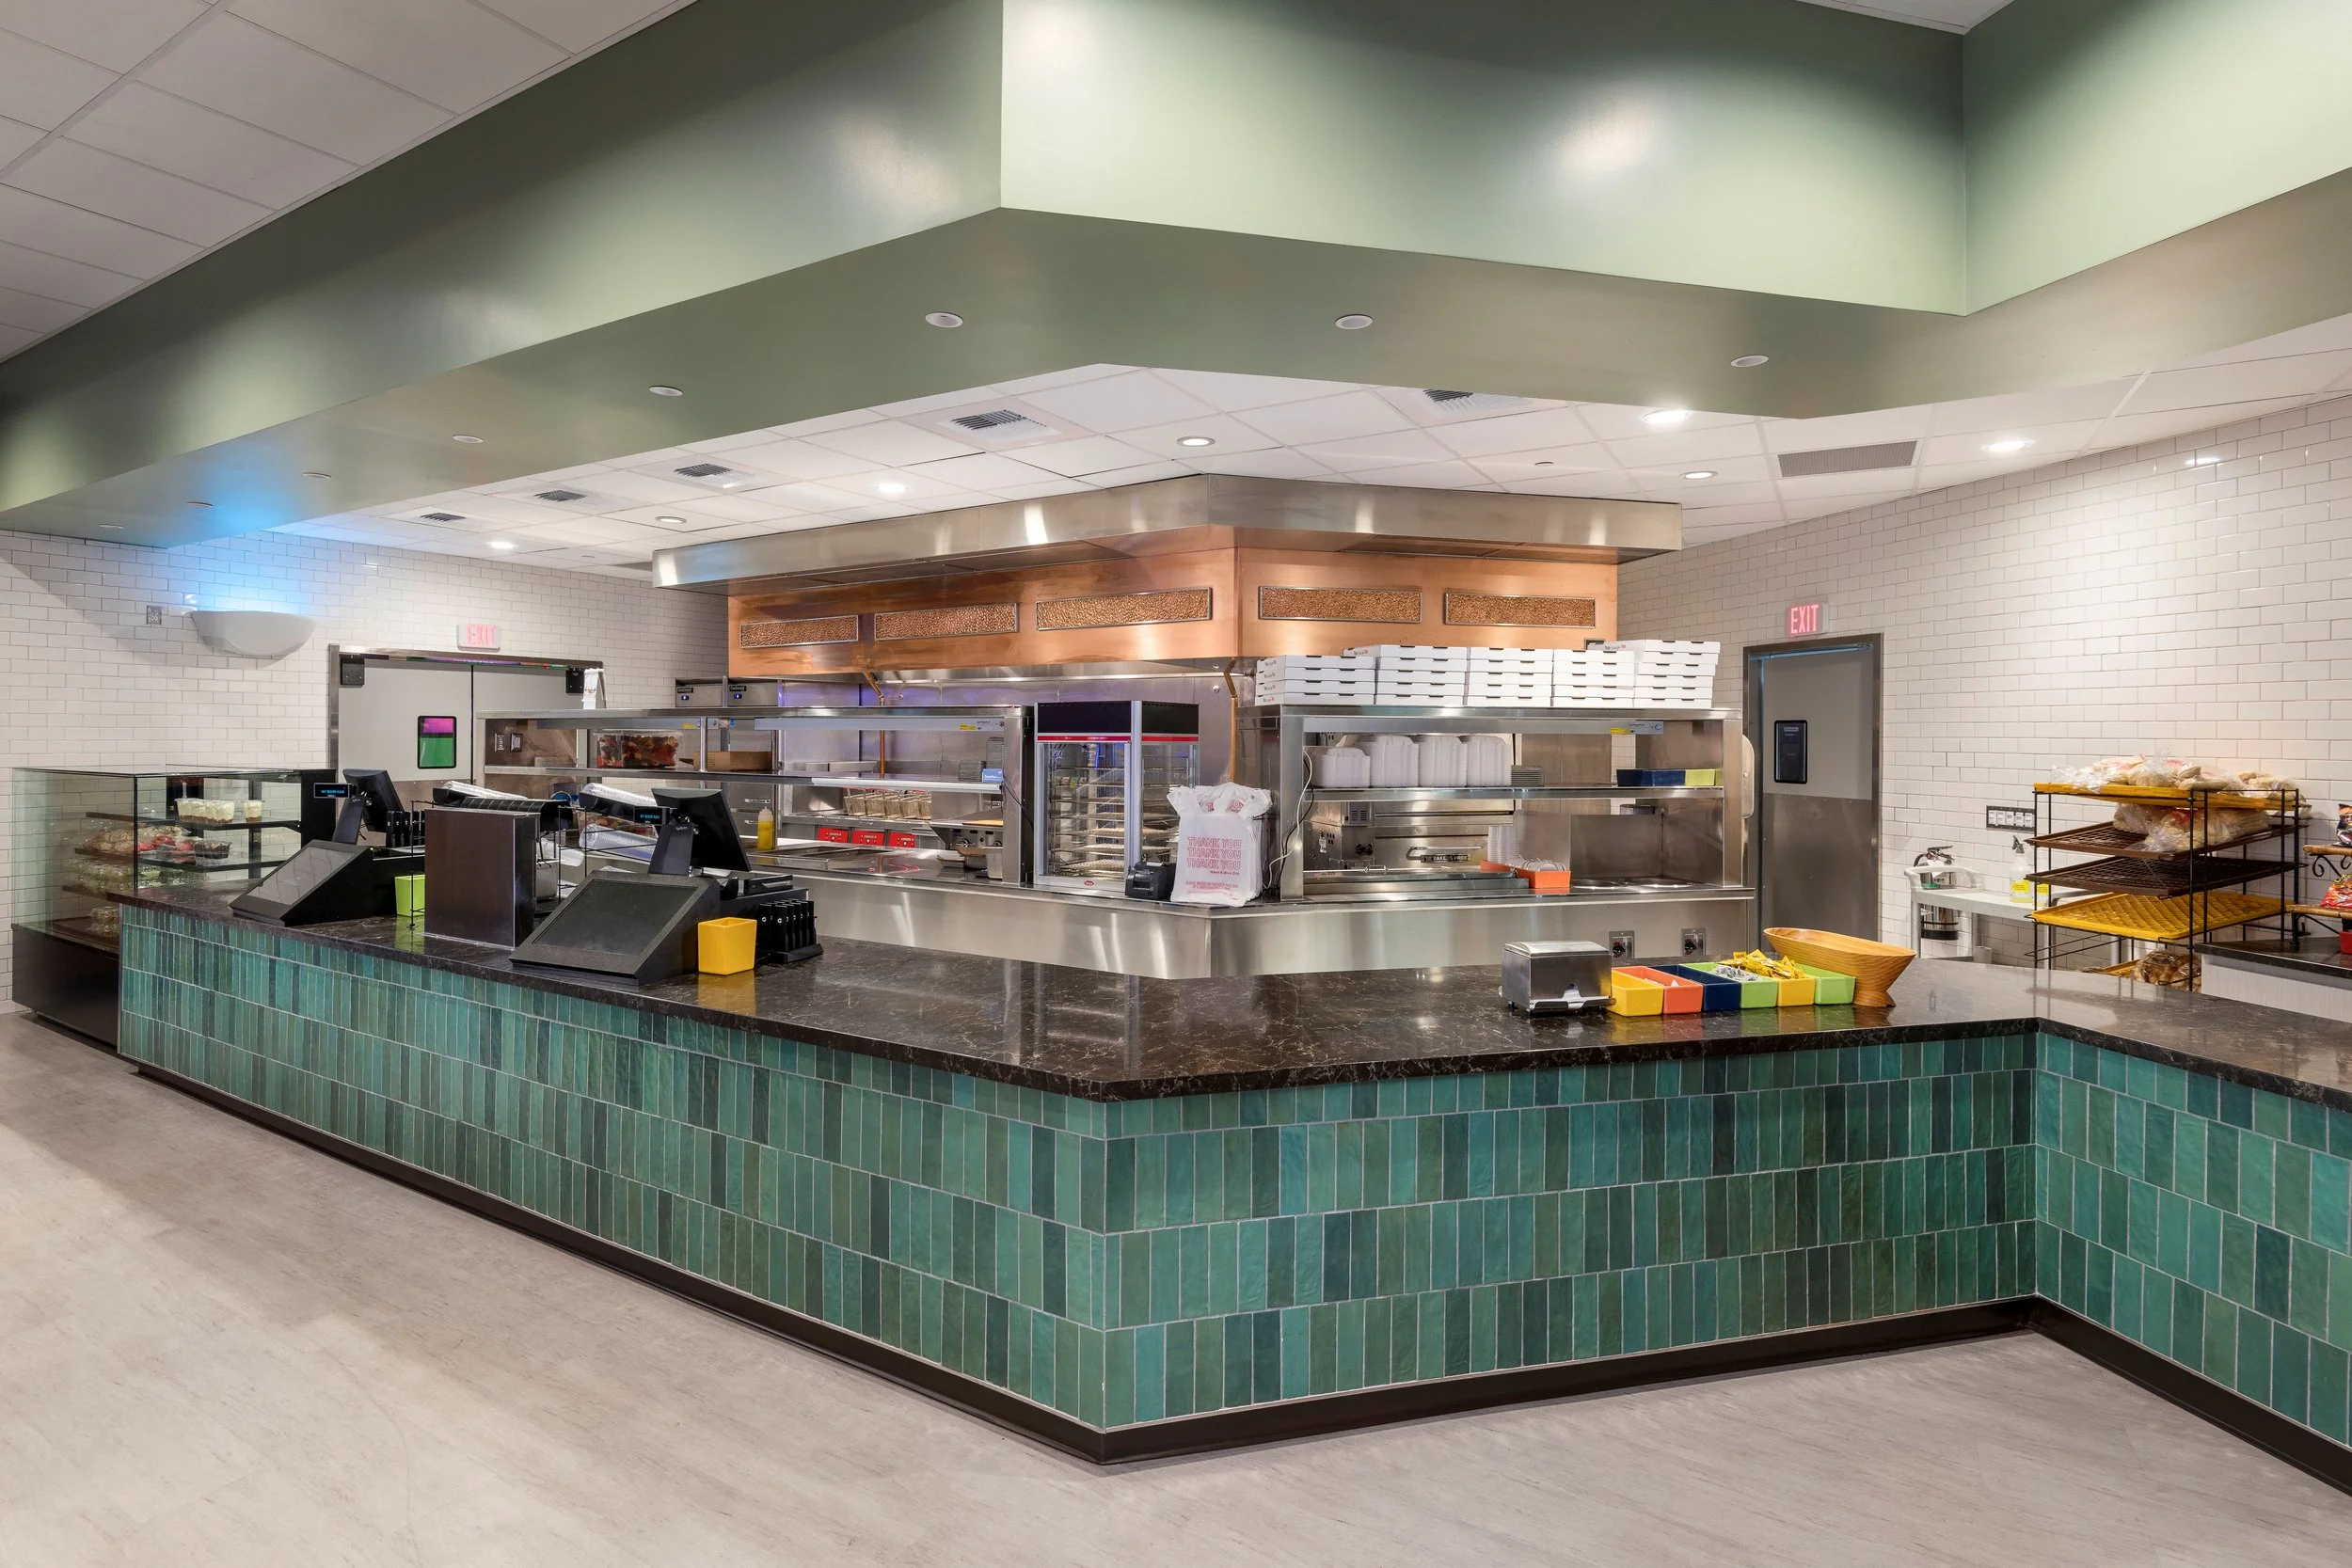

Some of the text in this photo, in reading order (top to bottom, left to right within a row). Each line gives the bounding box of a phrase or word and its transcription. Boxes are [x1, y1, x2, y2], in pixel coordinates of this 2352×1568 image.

[1790, 604, 1819, 634] EXIT
[467, 623, 496, 647] EXIT
[1187, 836, 1242, 848] THANK YOU
[1187, 847, 1242, 860] THANK YOU
[1186, 858, 1241, 870] THANK YOU
